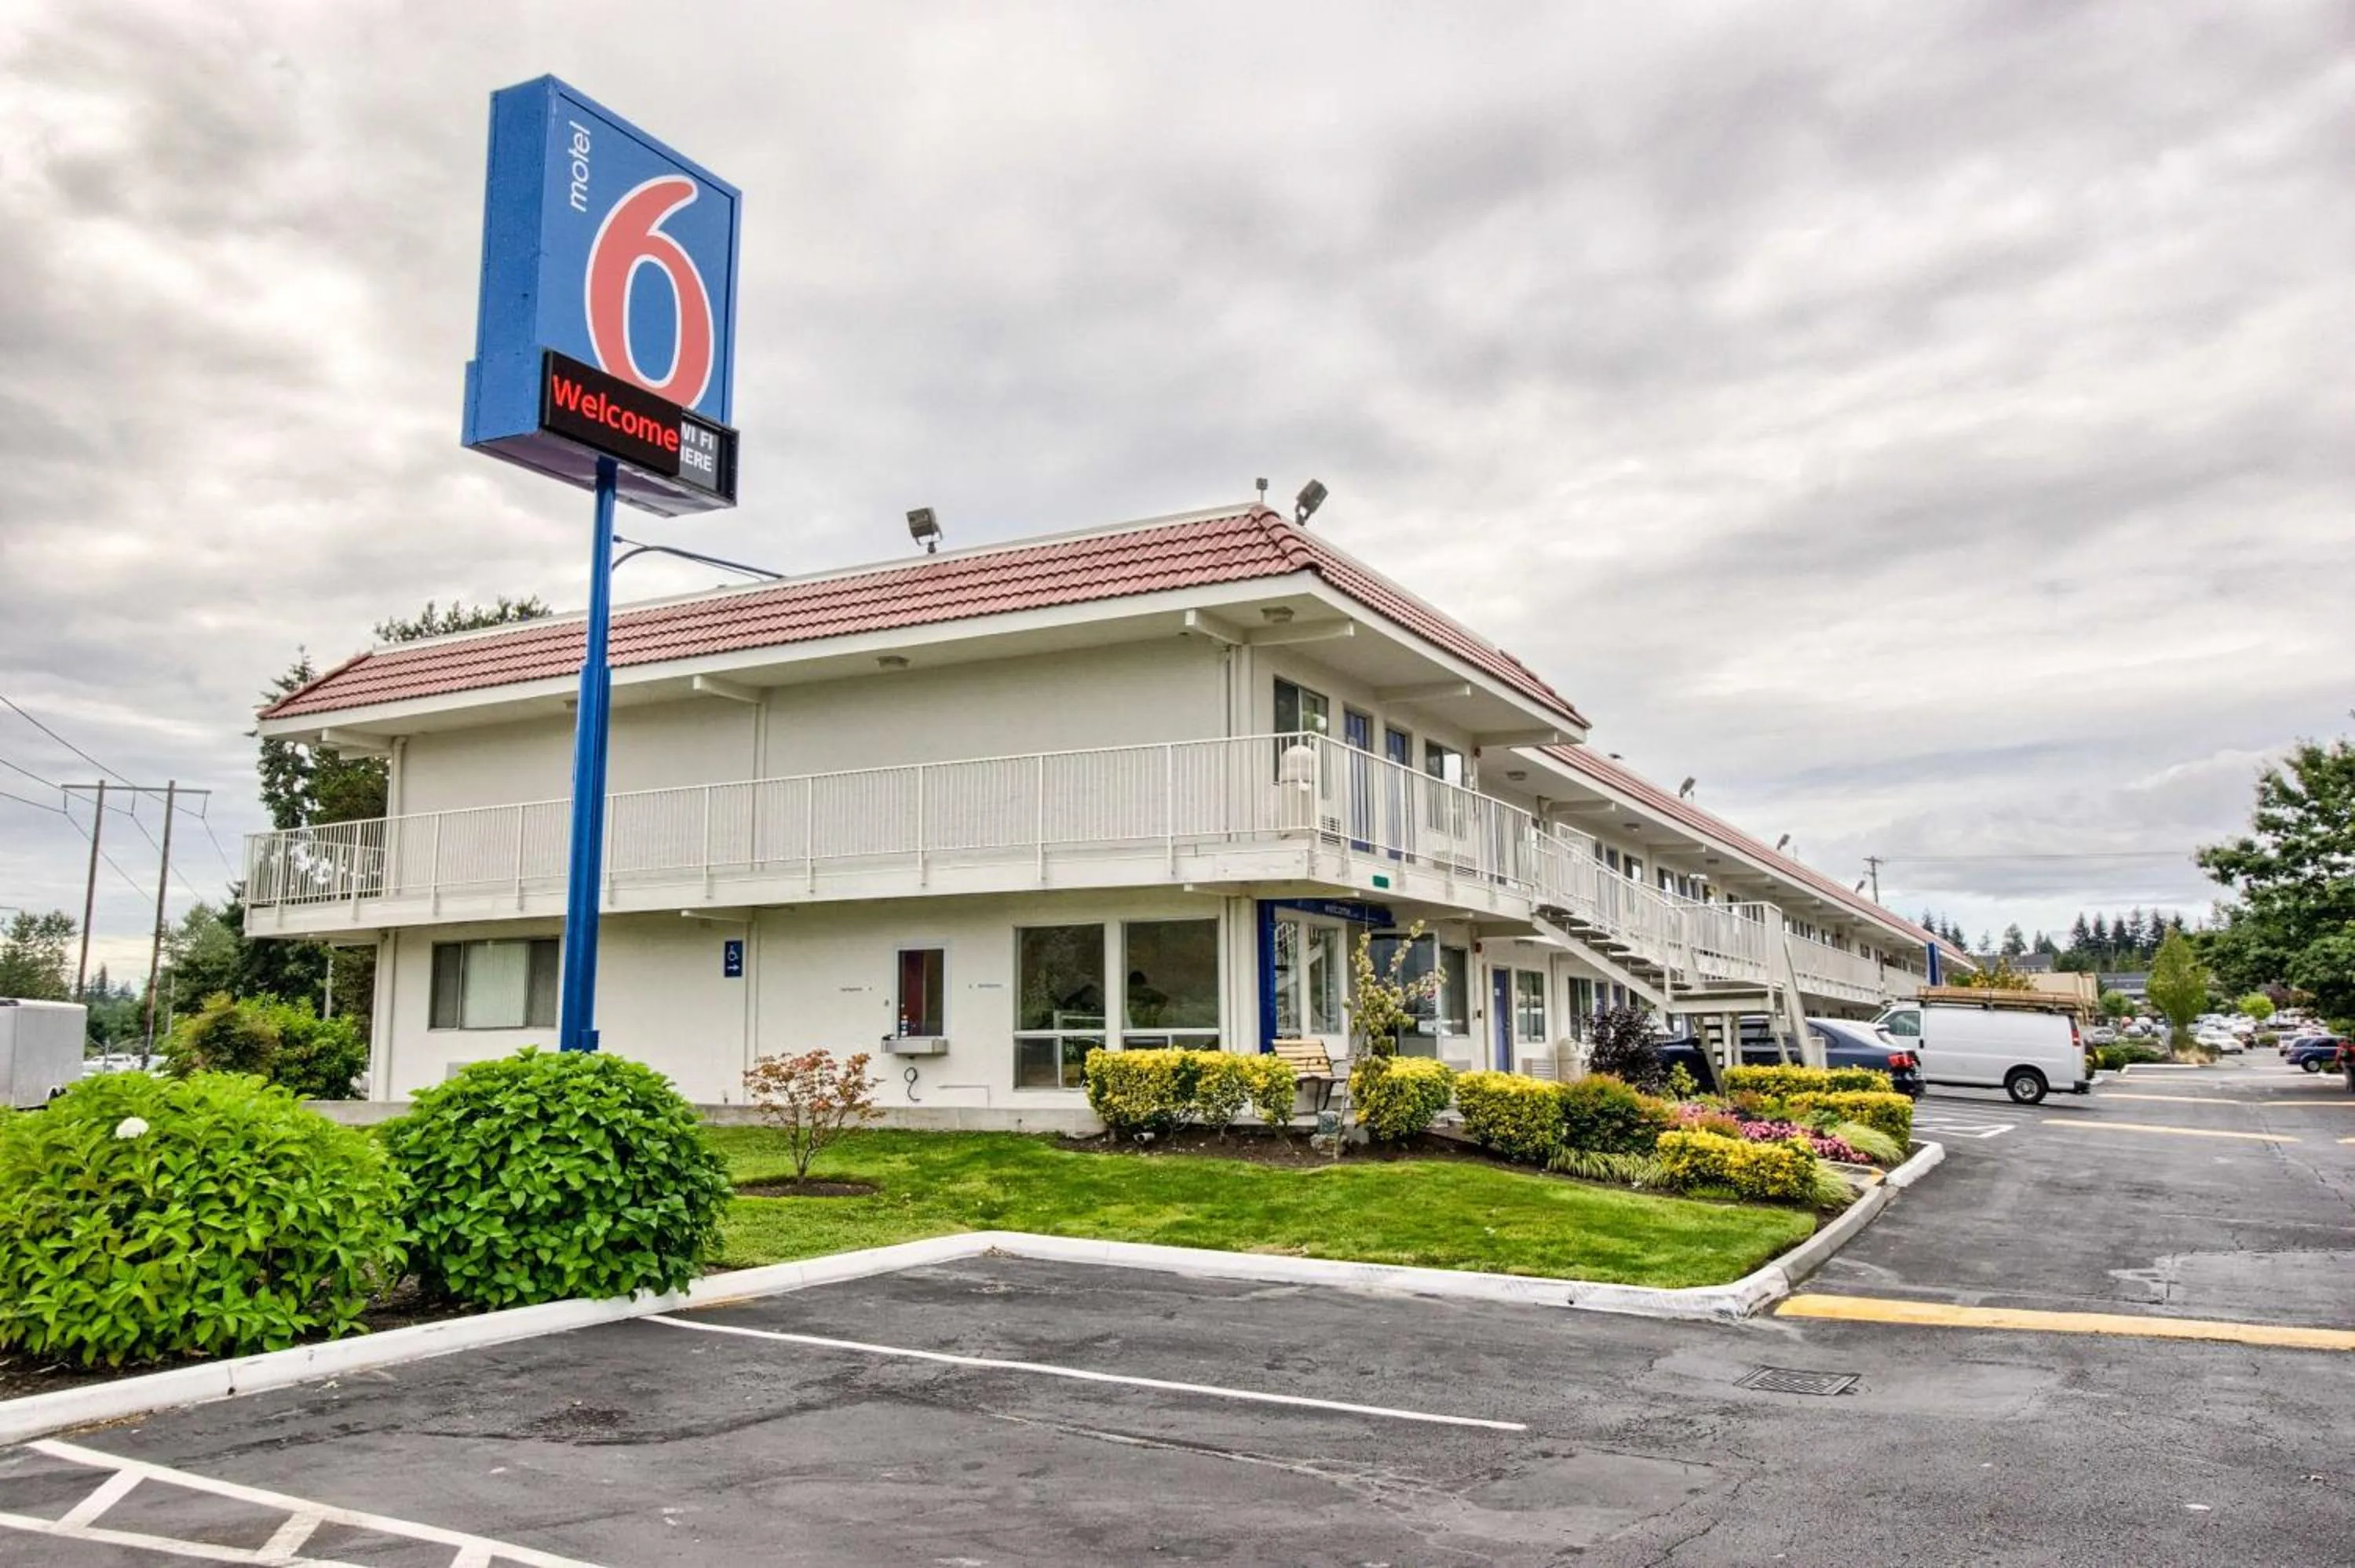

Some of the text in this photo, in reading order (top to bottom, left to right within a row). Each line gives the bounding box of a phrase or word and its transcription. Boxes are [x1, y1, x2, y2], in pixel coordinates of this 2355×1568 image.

[568, 120, 590, 212] motel
[584, 174, 714, 410] 6
[552, 374, 680, 452] Welcome
[700, 430, 713, 450] FI
